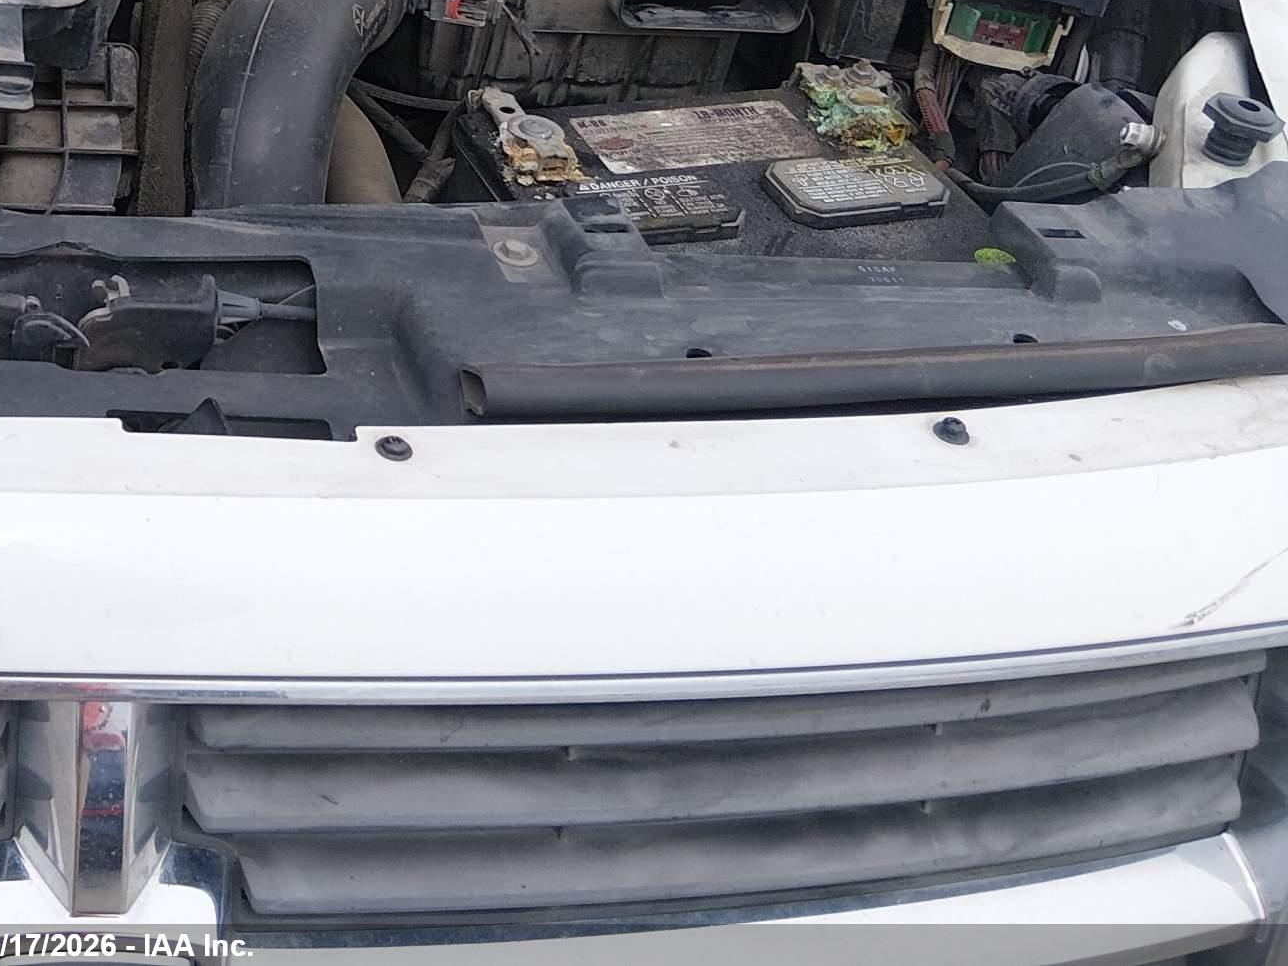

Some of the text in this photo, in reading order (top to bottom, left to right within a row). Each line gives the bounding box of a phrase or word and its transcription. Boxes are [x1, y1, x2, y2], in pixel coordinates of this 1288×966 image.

[694, 106, 759, 120] 18-MONTH
[589, 179, 642, 191] DANGER
[650, 174, 698, 185] POISON
